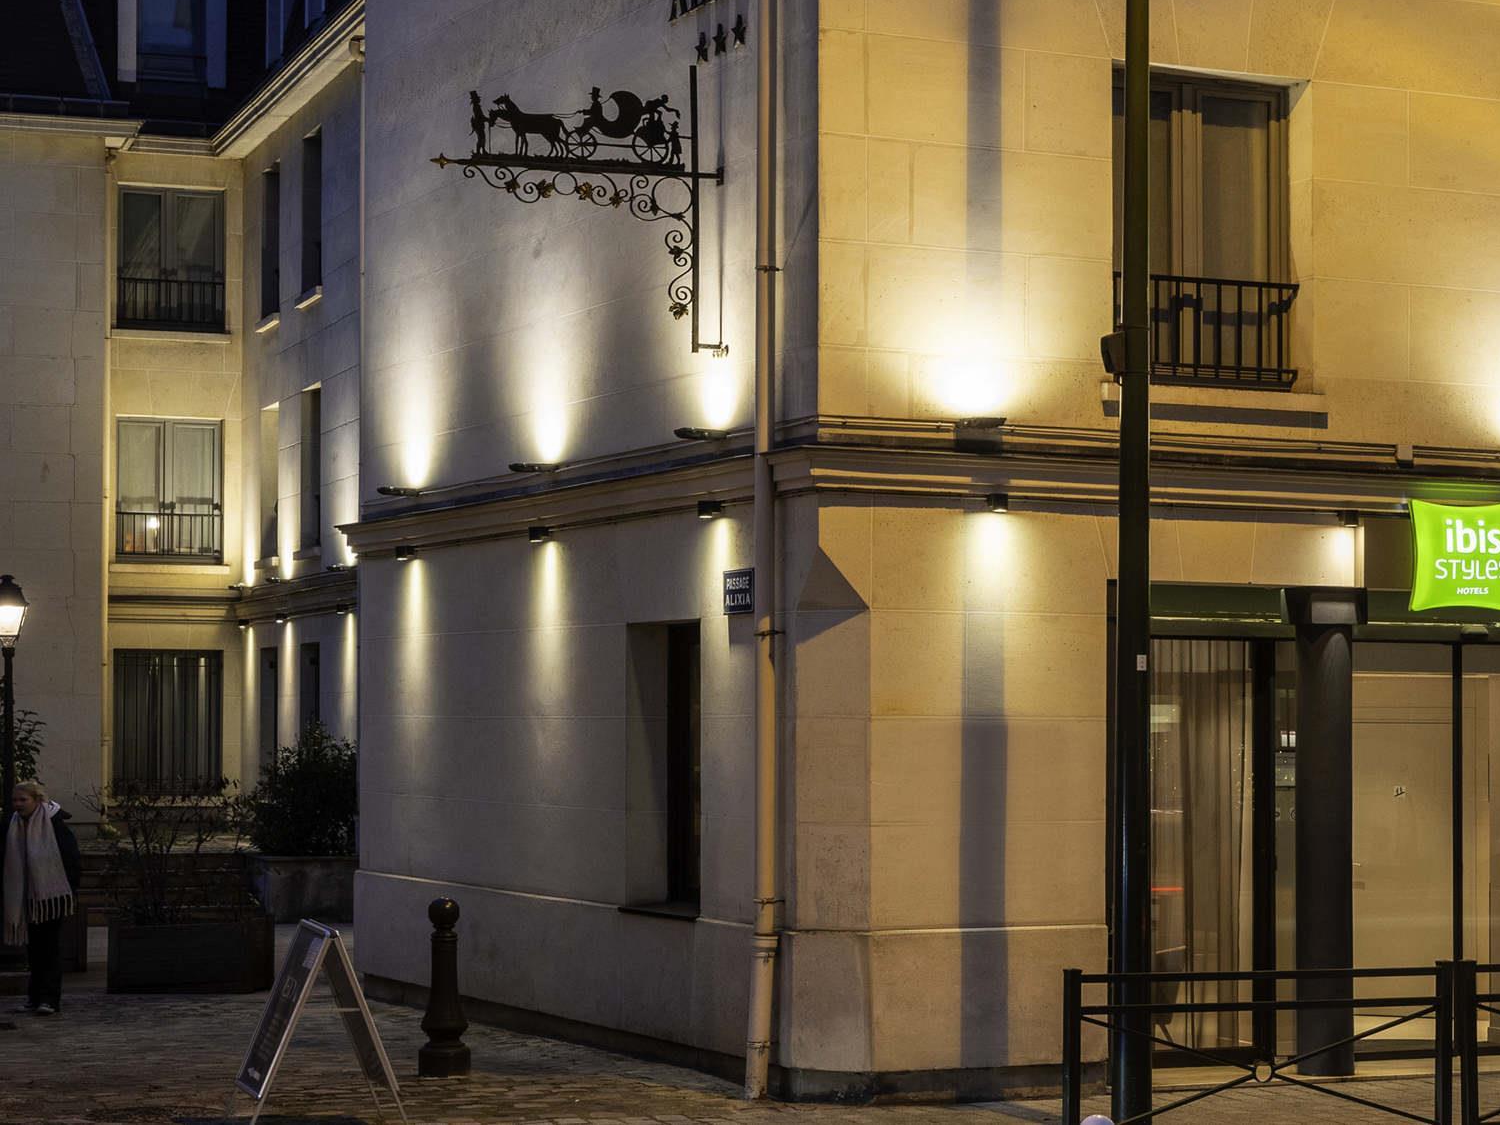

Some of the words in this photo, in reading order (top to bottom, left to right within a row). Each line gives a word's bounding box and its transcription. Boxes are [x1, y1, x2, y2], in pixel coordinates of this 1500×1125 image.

[726, 576, 749, 590] PASSAGE
[1456, 587, 1489, 595] HOTELS
[725, 593, 750, 606] ALIXIA
